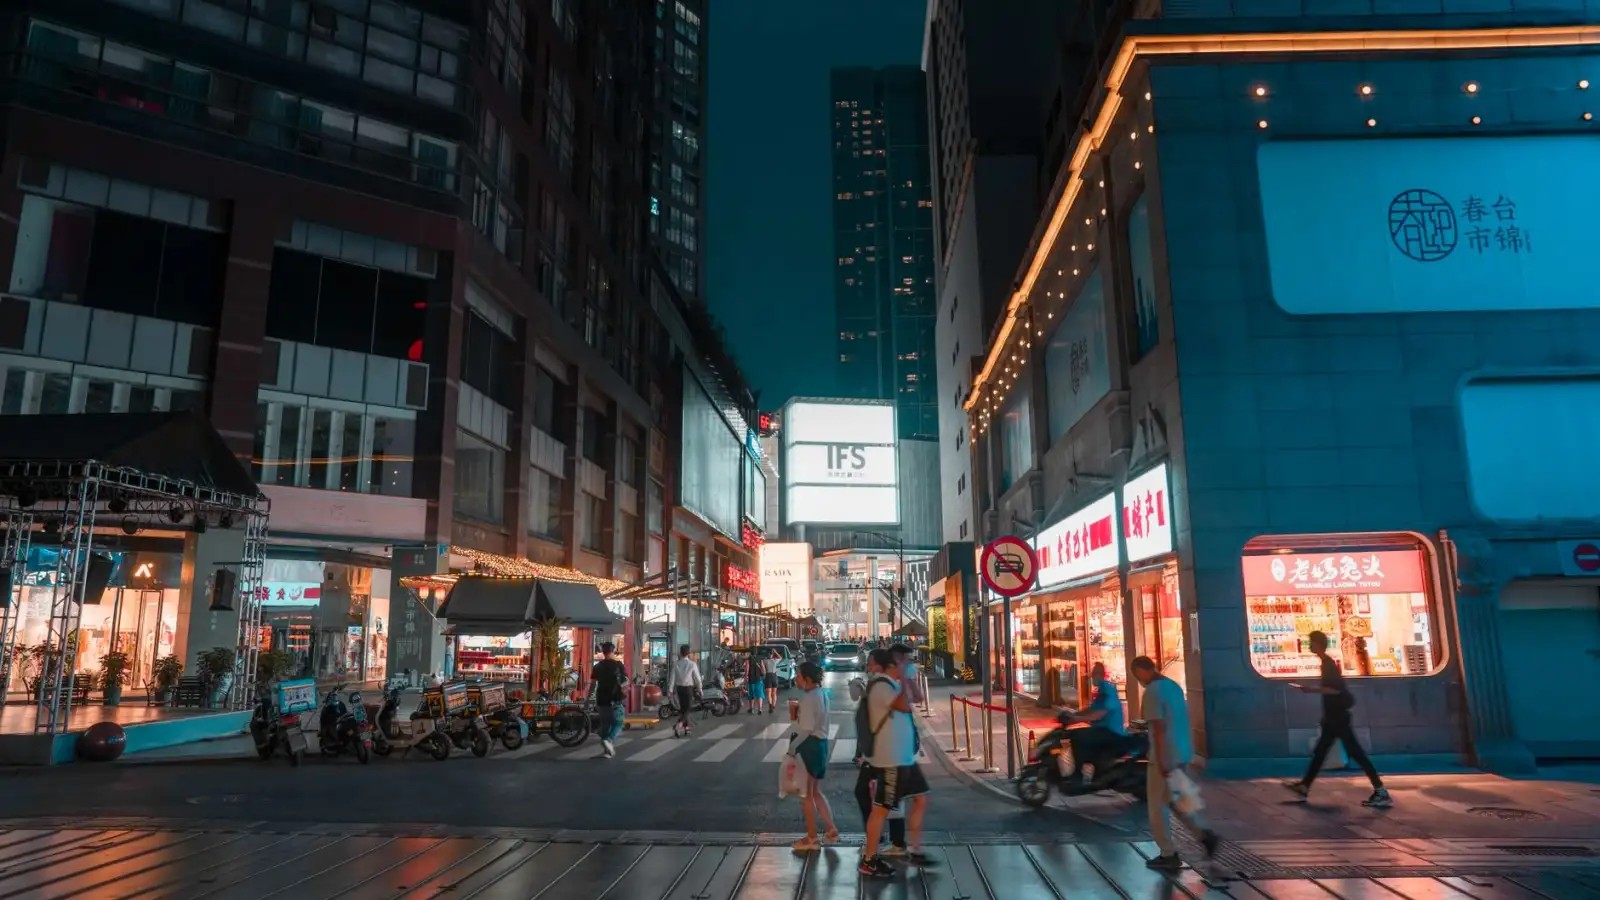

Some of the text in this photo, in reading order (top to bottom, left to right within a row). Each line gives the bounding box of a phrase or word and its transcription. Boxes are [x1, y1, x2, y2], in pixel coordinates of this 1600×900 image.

[827, 444, 866, 470] IFS
[1289, 554, 1385, 584] 老妈兔头
